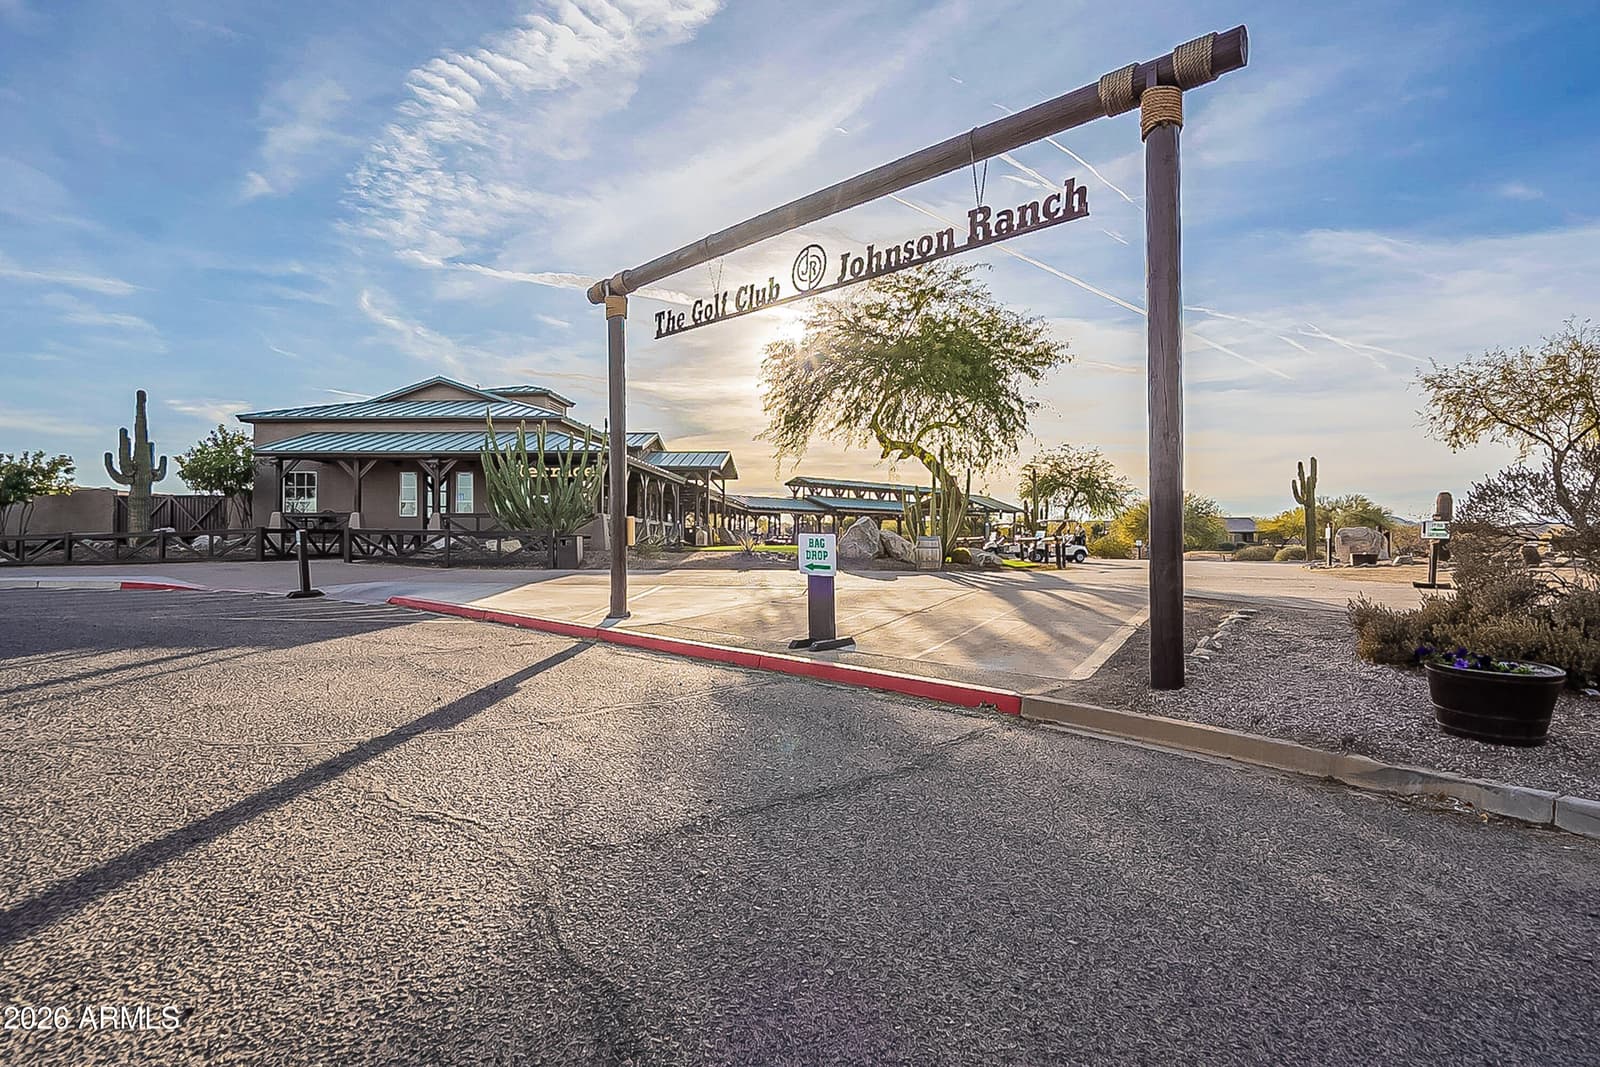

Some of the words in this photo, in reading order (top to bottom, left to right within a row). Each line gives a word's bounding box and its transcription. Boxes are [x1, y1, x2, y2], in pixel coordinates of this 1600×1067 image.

[654, 310, 686, 336] The
[692, 291, 728, 325] Golf
[736, 276, 780, 313] Club
[837, 226, 956, 286] Johnson
[966, 177, 1089, 246] Ranch
[808, 538, 825, 548] BAG
[805, 550, 829, 561] DROP
